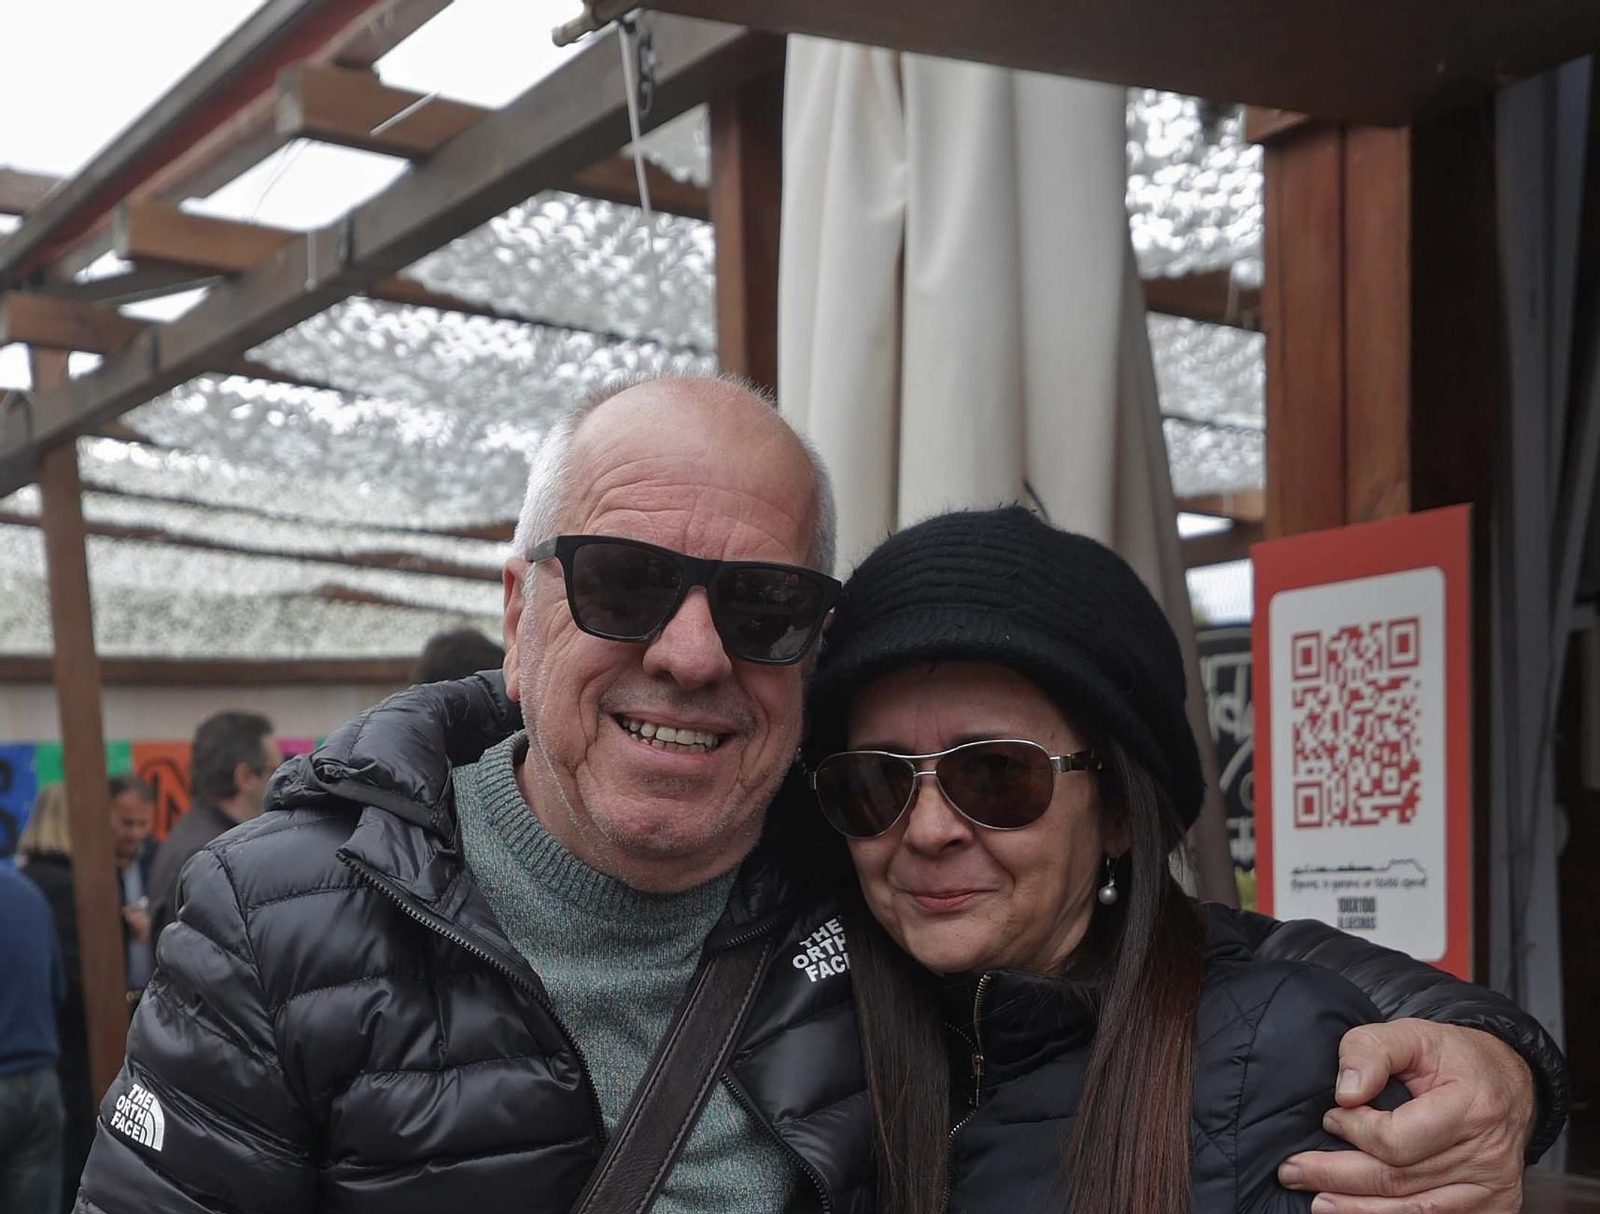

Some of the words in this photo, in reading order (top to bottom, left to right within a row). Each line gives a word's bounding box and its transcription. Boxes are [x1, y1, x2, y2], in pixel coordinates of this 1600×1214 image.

[799, 918, 843, 948] THE
[128, 1083, 155, 1111] THE
[110, 1111, 141, 1142] FACE
